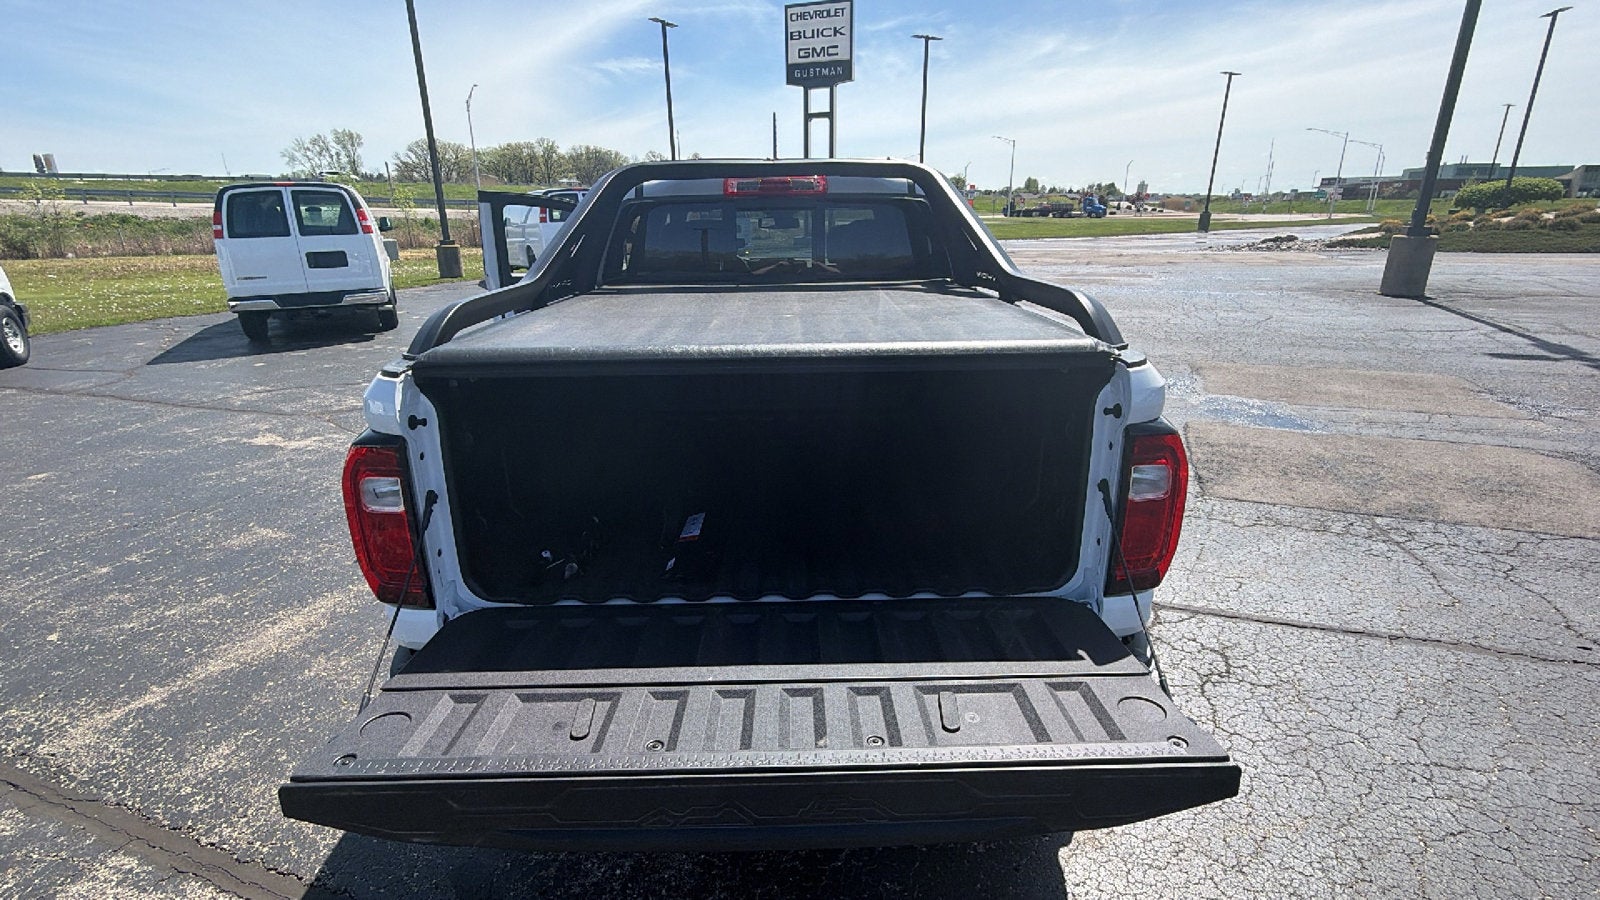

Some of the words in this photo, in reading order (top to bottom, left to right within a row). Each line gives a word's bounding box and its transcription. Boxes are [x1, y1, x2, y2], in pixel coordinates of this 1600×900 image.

[789, 7, 846, 22] CHEVROLET
[789, 26, 846, 41] BUICK
[798, 45, 839, 59] GMC
[794, 66, 842, 78] GUSTMAN
